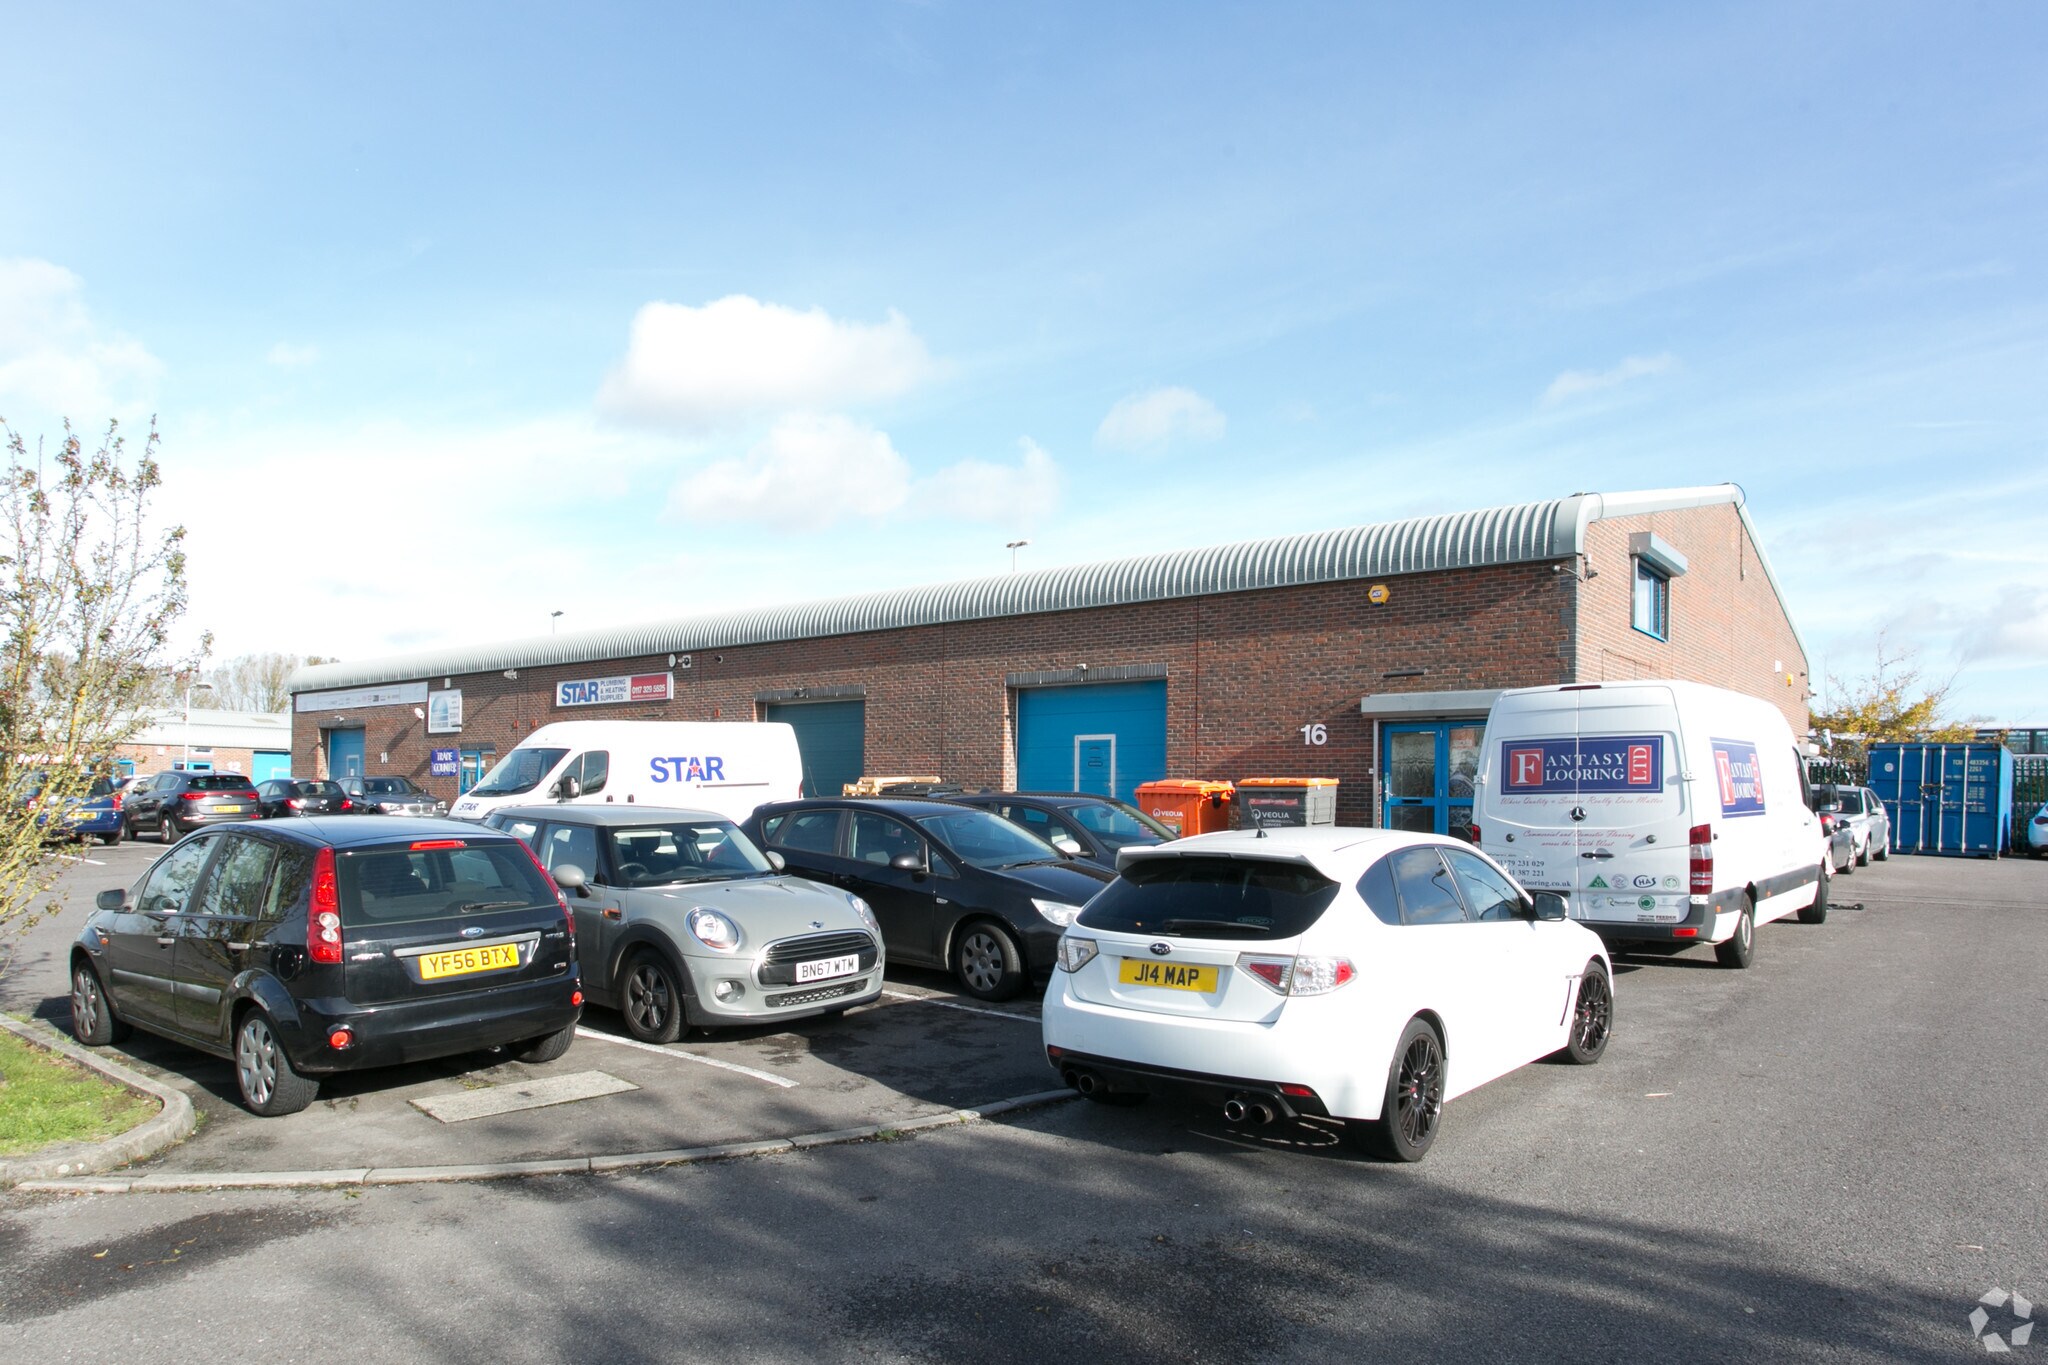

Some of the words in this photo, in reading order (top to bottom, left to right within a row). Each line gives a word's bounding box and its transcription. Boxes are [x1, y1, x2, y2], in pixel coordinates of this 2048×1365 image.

[600, 679, 626, 687] PLUMBING
[561, 681, 599, 704] STAR
[605, 686, 627, 694] HEATING
[600, 693, 624, 701] SUPPLIES
[1301, 724, 1328, 745] 16
[436, 751, 453, 761] TRADE
[433, 763, 457, 773] COUNTER
[1632, 747, 1648, 781] LTD
[650, 756, 725, 783] STAR
[1500, 797, 1520, 805] Where
[1523, 797, 1548, 806] Quality
[1589, 796, 1612, 806] Really
[459, 802, 480, 811] STAR
[1161, 810, 1184, 818] VEOLIA
[1262, 811, 1290, 819] VEOLIA
[1574, 830, 1603, 838] Domestic
[1606, 830, 1635, 839] Flooring
[1517, 879, 1572, 888] flooring.co.uk
[428, 953, 476, 973] YF56
[481, 947, 513, 967] BTX
[801, 961, 831, 978] BN67
[833, 957, 855, 972] WTM
[1134, 963, 1160, 983] J14
[1164, 966, 1200, 986] MAP
